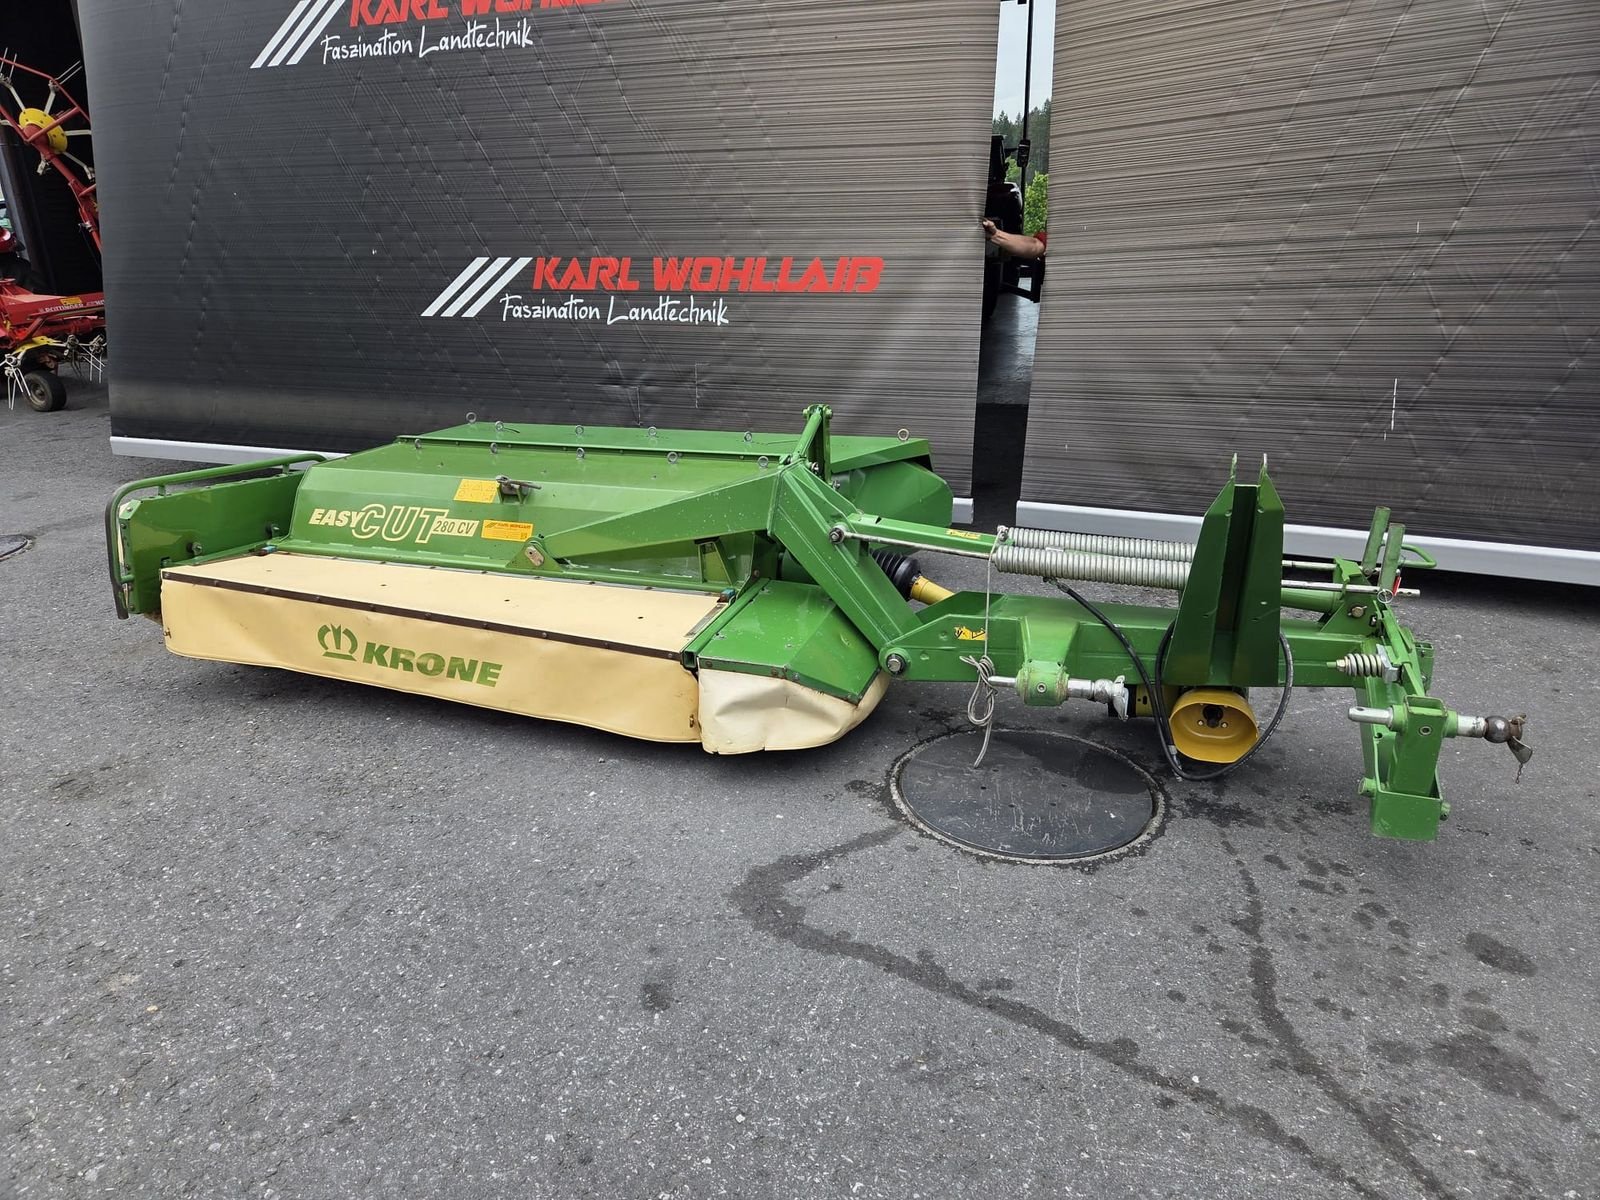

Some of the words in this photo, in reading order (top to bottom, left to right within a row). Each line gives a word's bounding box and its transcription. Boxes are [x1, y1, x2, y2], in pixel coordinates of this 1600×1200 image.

[349, 0, 449, 27] KARL
[320, 28, 413, 65] Faszination
[418, 17, 534, 58] Landtechnik
[532, 257, 640, 291] KARL
[500, 293, 601, 323] Faszination
[606, 295, 730, 326] Landtechnik
[432, 520, 455, 534] 280
[457, 520, 476, 535] CV
[362, 641, 503, 688] KRONE
